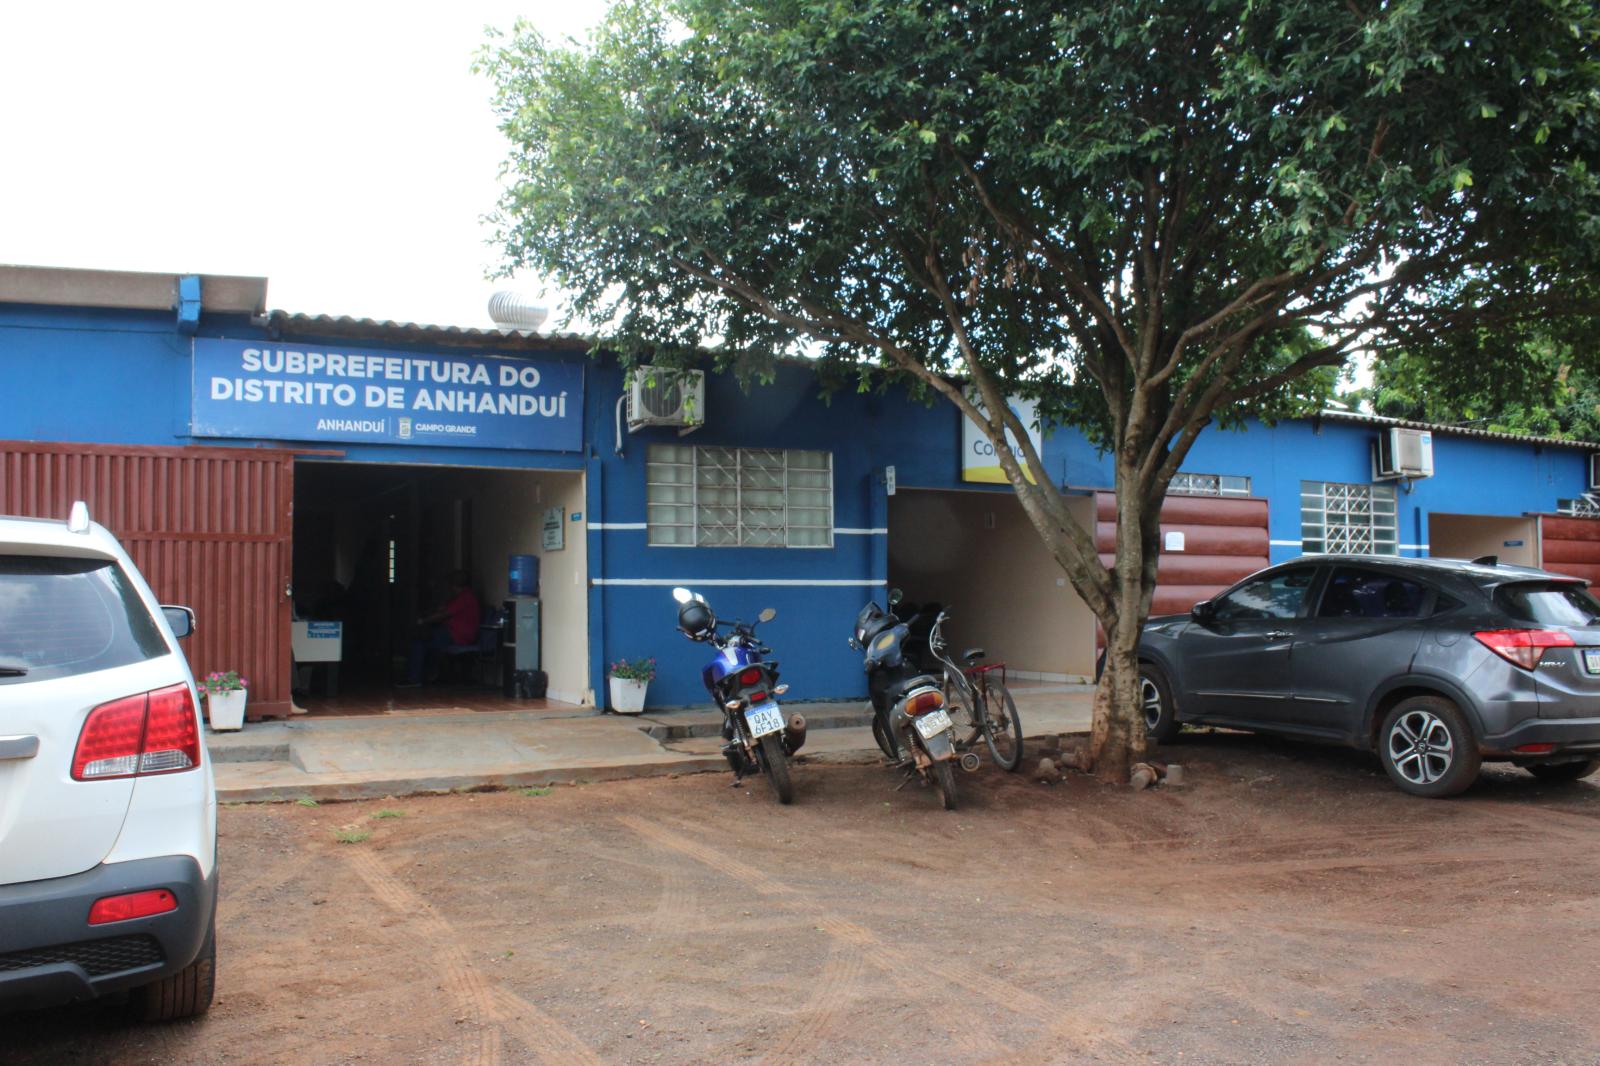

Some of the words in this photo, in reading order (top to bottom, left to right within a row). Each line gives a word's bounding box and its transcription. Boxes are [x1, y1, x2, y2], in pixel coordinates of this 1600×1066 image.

[241, 348, 491, 387] SUBPREFEITURA
[498, 364, 541, 389] DO
[210, 376, 357, 407] DISTRITO
[365, 385, 407, 410] DE
[412, 389, 568, 419] ANHANDUÍ
[316, 418, 385, 434] ANHANDUÍ
[415, 422, 445, 433] CAMPO
[446, 424, 477, 434] GRANDE
[755, 718, 781, 735] 6F18
